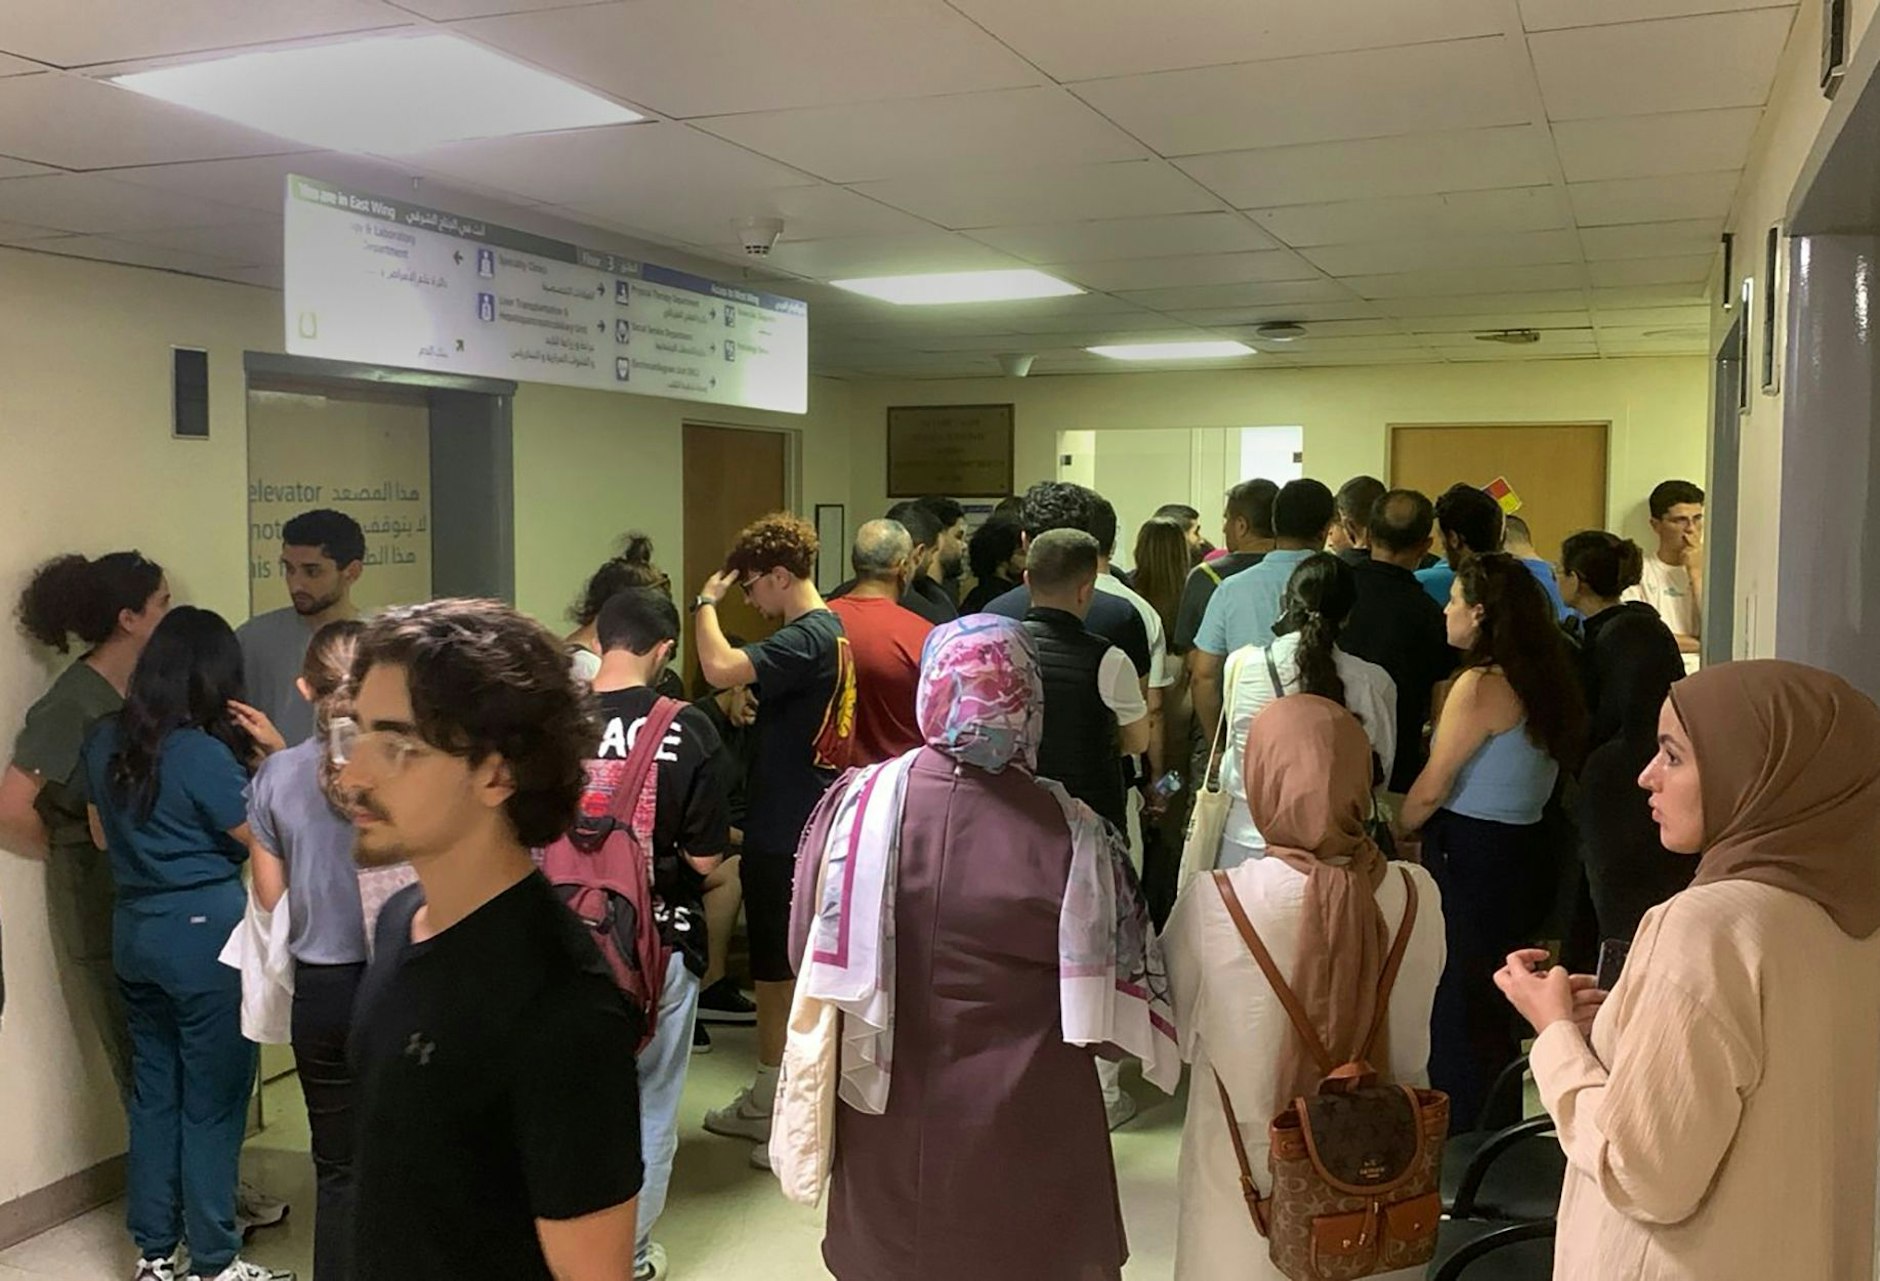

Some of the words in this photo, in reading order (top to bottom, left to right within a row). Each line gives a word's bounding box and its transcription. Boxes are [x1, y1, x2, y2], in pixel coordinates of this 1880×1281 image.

[320, 190, 337, 206] are
[338, 191, 348, 208] in
[350, 195, 371, 213] East
[371, 200, 397, 221] Wing
[607, 255, 615, 271] 3
[248, 478, 323, 503] elevator
[332, 481, 393, 502] المصعد
[416, 514, 427, 532] لا
[392, 544, 416, 564] هذا
